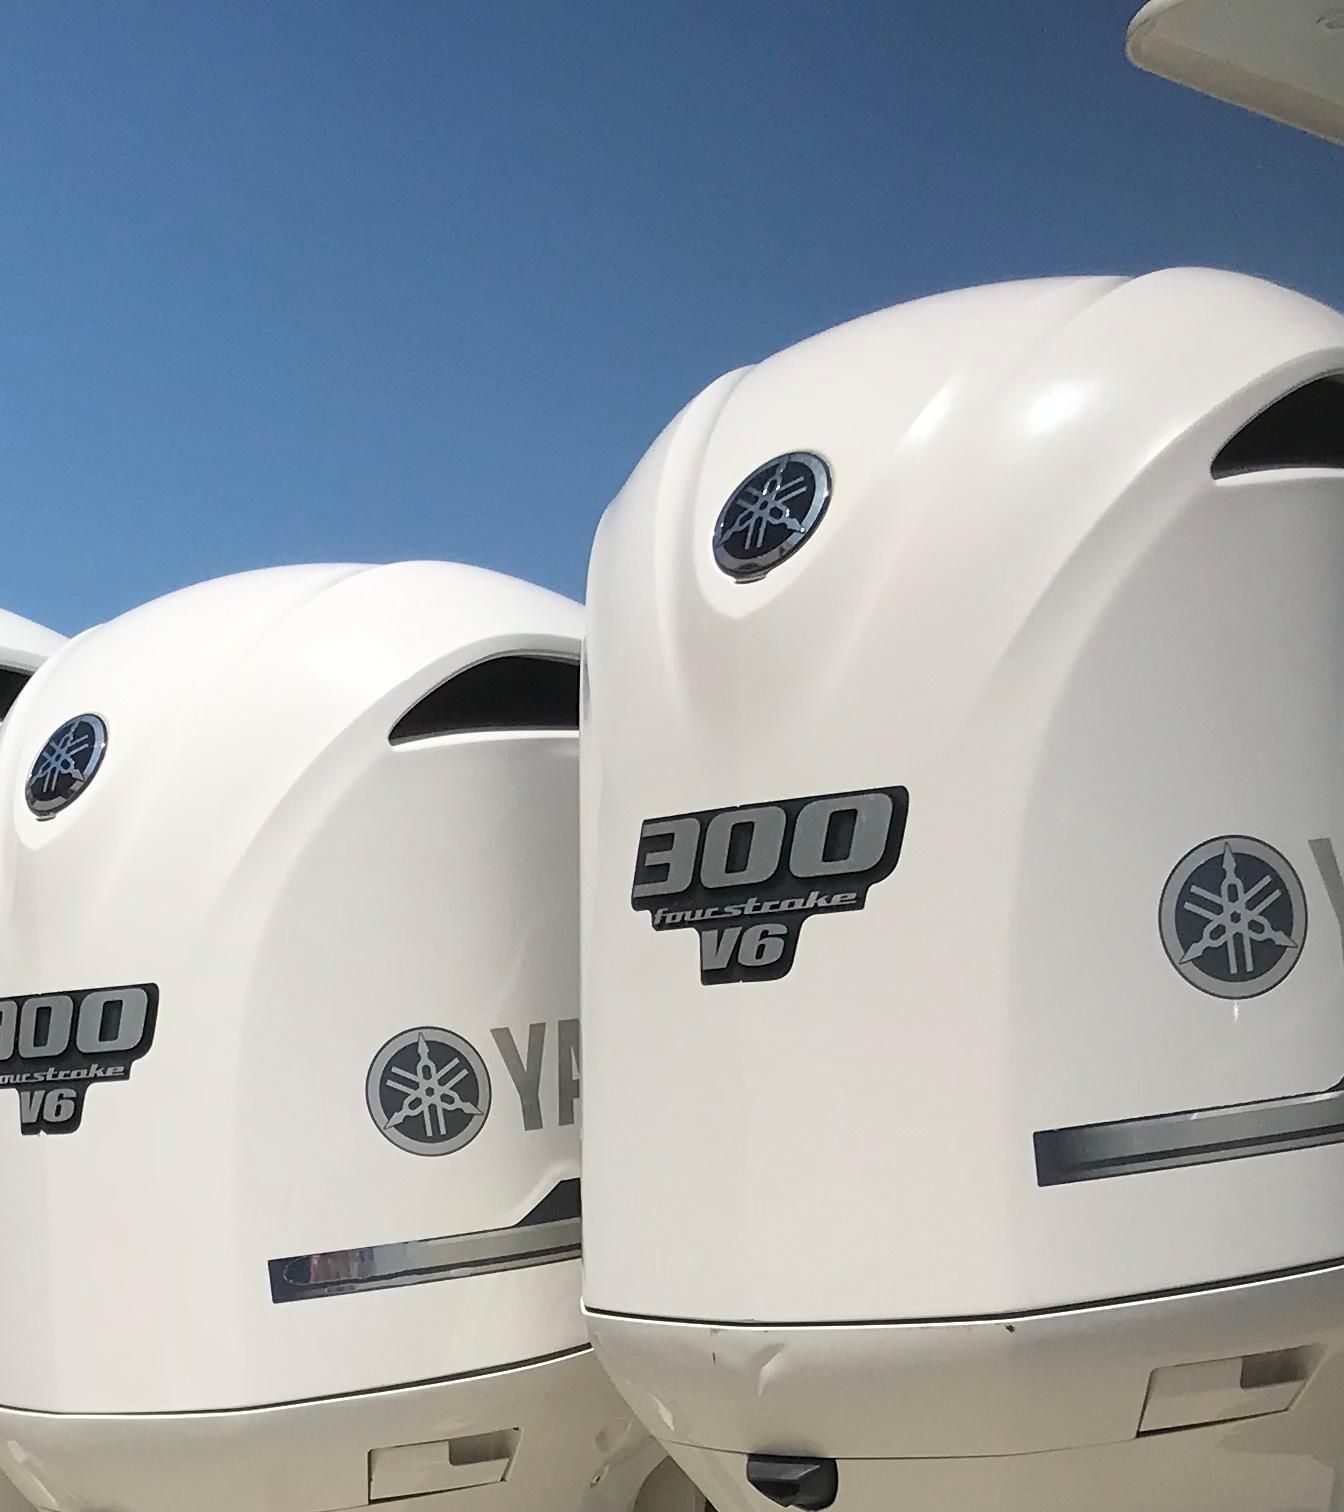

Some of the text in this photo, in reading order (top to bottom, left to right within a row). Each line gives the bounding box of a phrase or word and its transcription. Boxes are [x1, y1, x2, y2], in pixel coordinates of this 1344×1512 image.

[633, 793, 893, 898] 300
[654, 891, 857, 925] fourstroke
[701, 923, 788, 970] V6
[20, 1088, 77, 1124] V6
